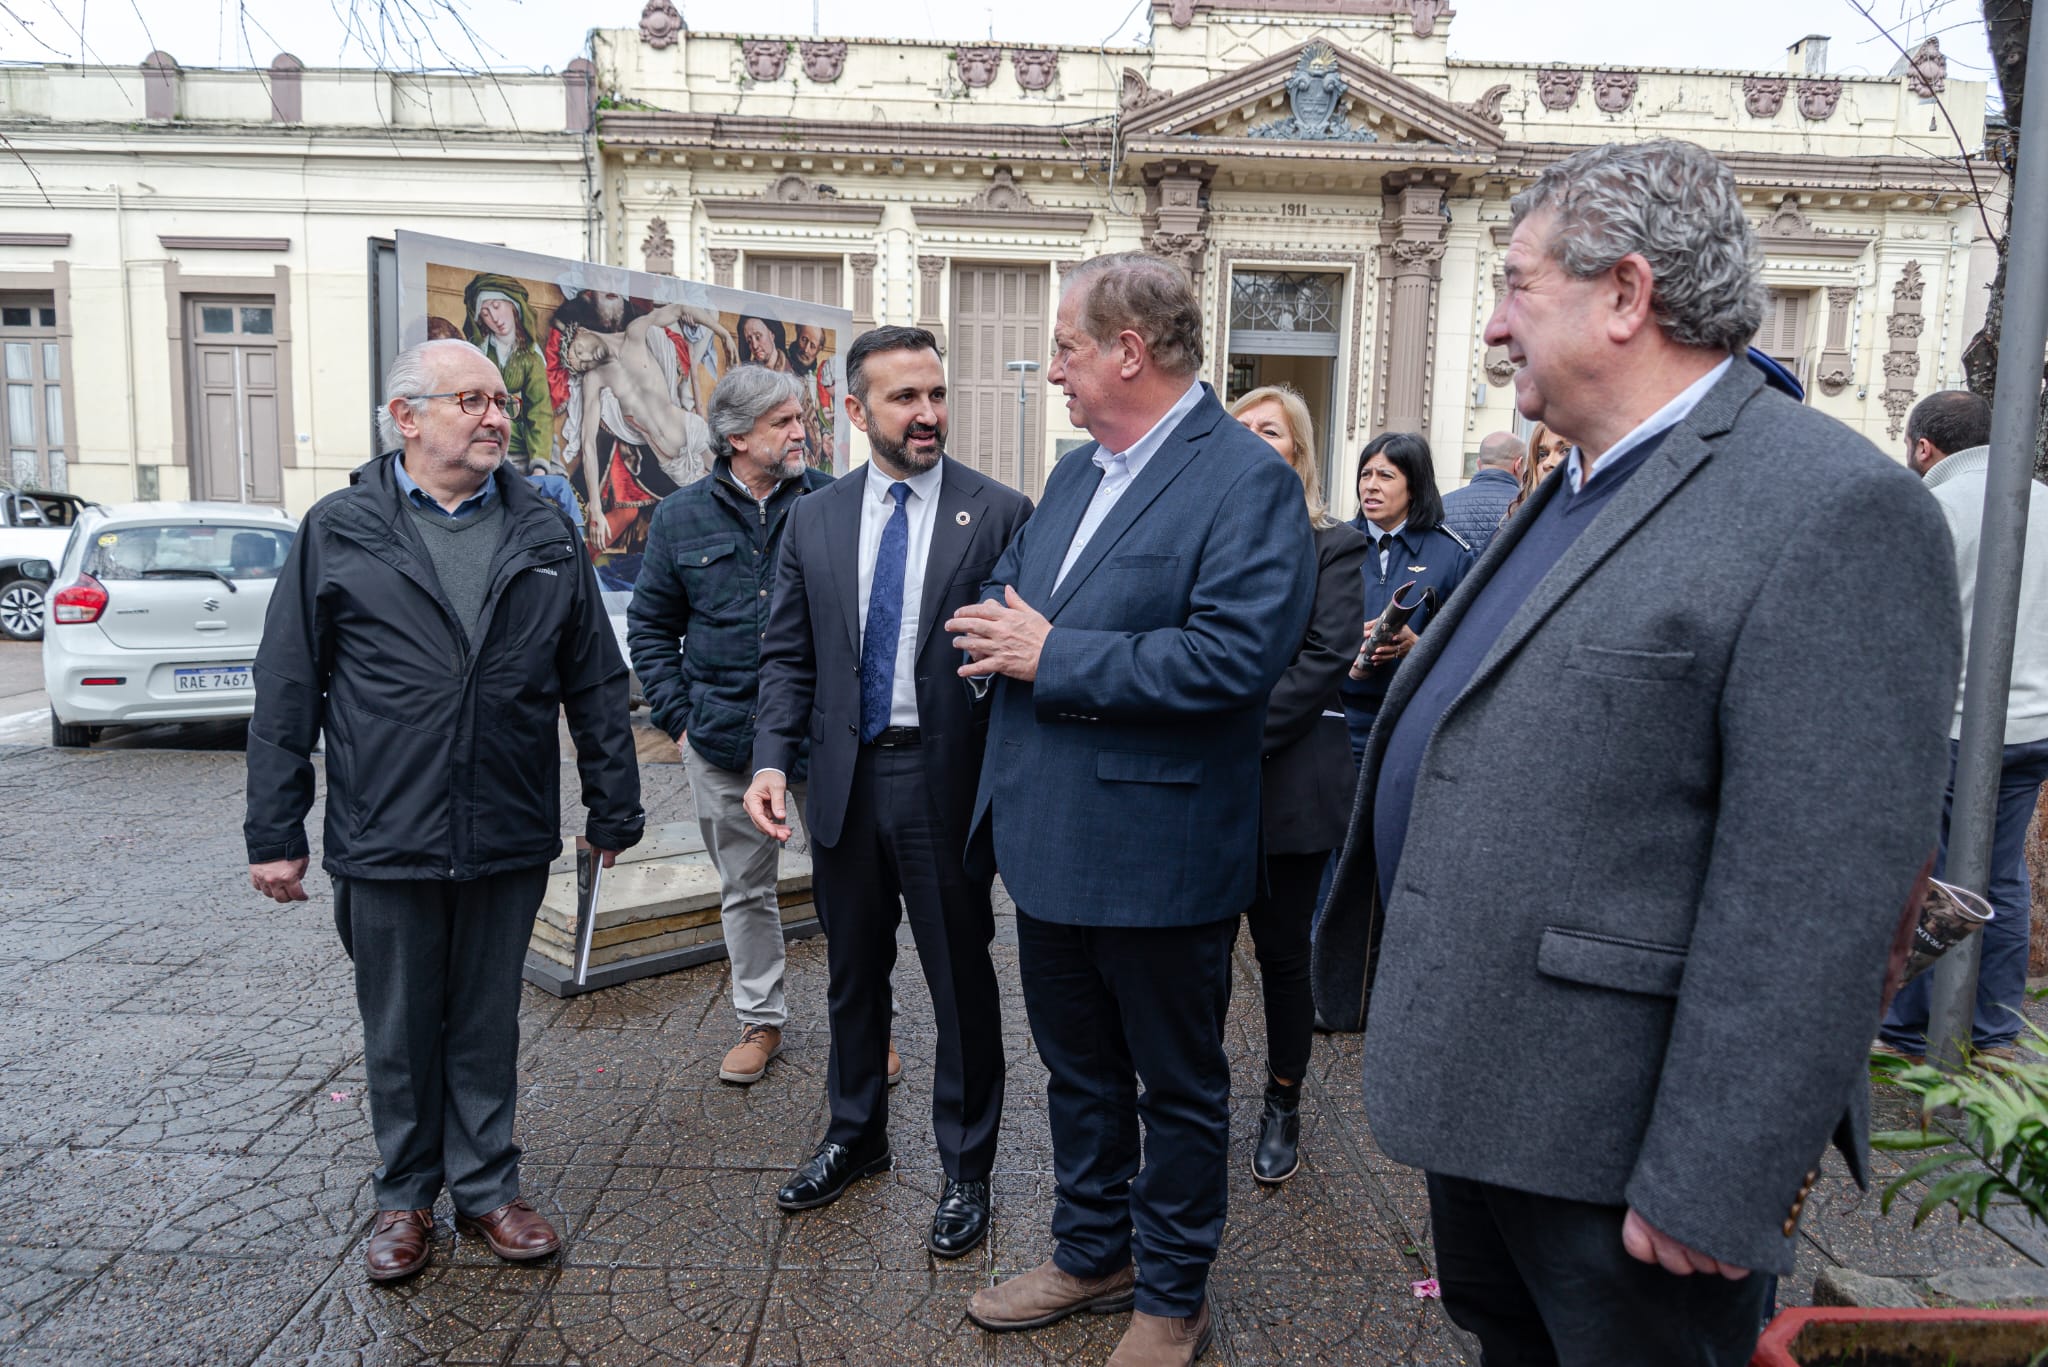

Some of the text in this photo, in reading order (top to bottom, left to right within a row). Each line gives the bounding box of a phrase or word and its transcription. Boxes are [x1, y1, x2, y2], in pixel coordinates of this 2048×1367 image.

[1281, 203, 1307, 216] 1911
[180, 674, 248, 689] RAE 7467
